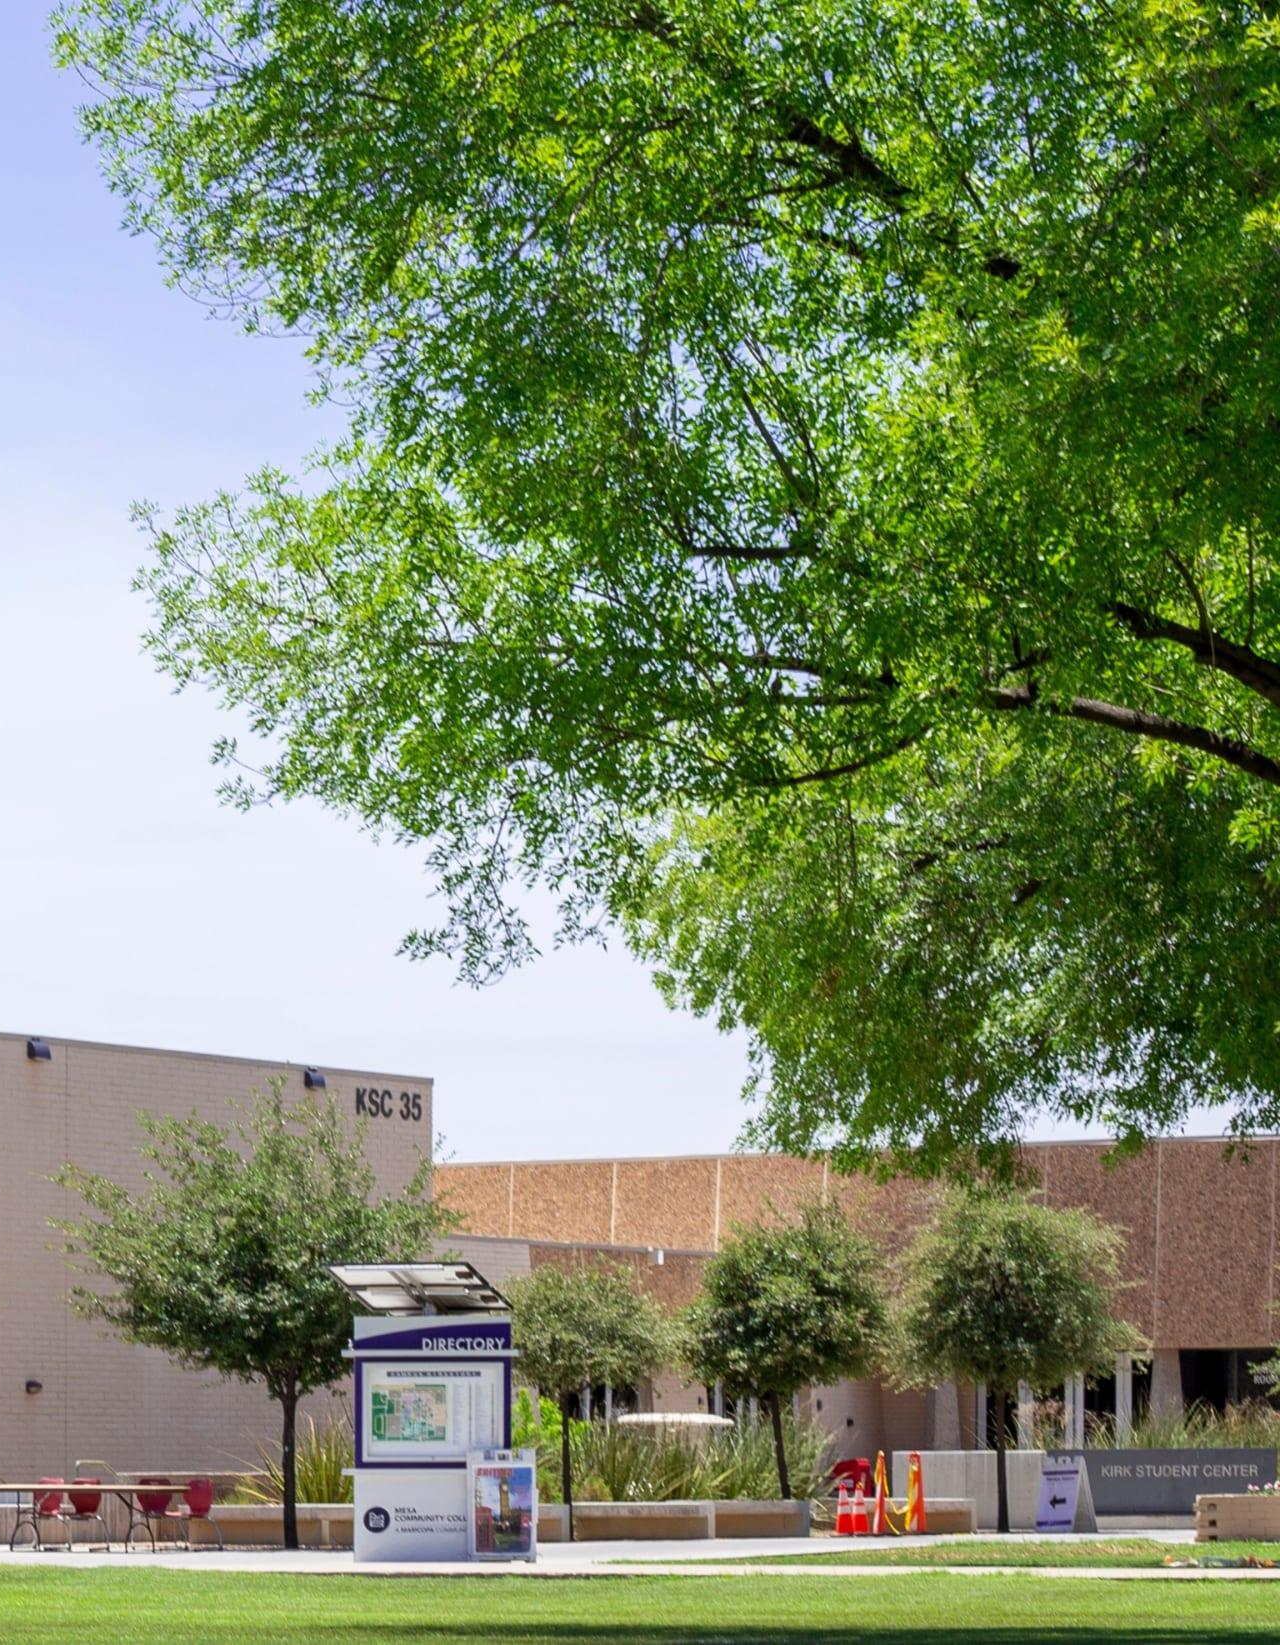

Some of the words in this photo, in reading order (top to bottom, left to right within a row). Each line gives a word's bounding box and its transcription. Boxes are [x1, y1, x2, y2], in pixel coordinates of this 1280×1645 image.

[355, 1088, 392, 1118] KSC
[400, 1092, 422, 1121] 35
[422, 1337, 505, 1350] DIRECTORY
[1101, 1465, 1133, 1477] KIRK
[1136, 1465, 1199, 1477] STUDENT
[1203, 1464, 1259, 1477] CENTER
[394, 1514, 444, 1522] COMMUNITY
